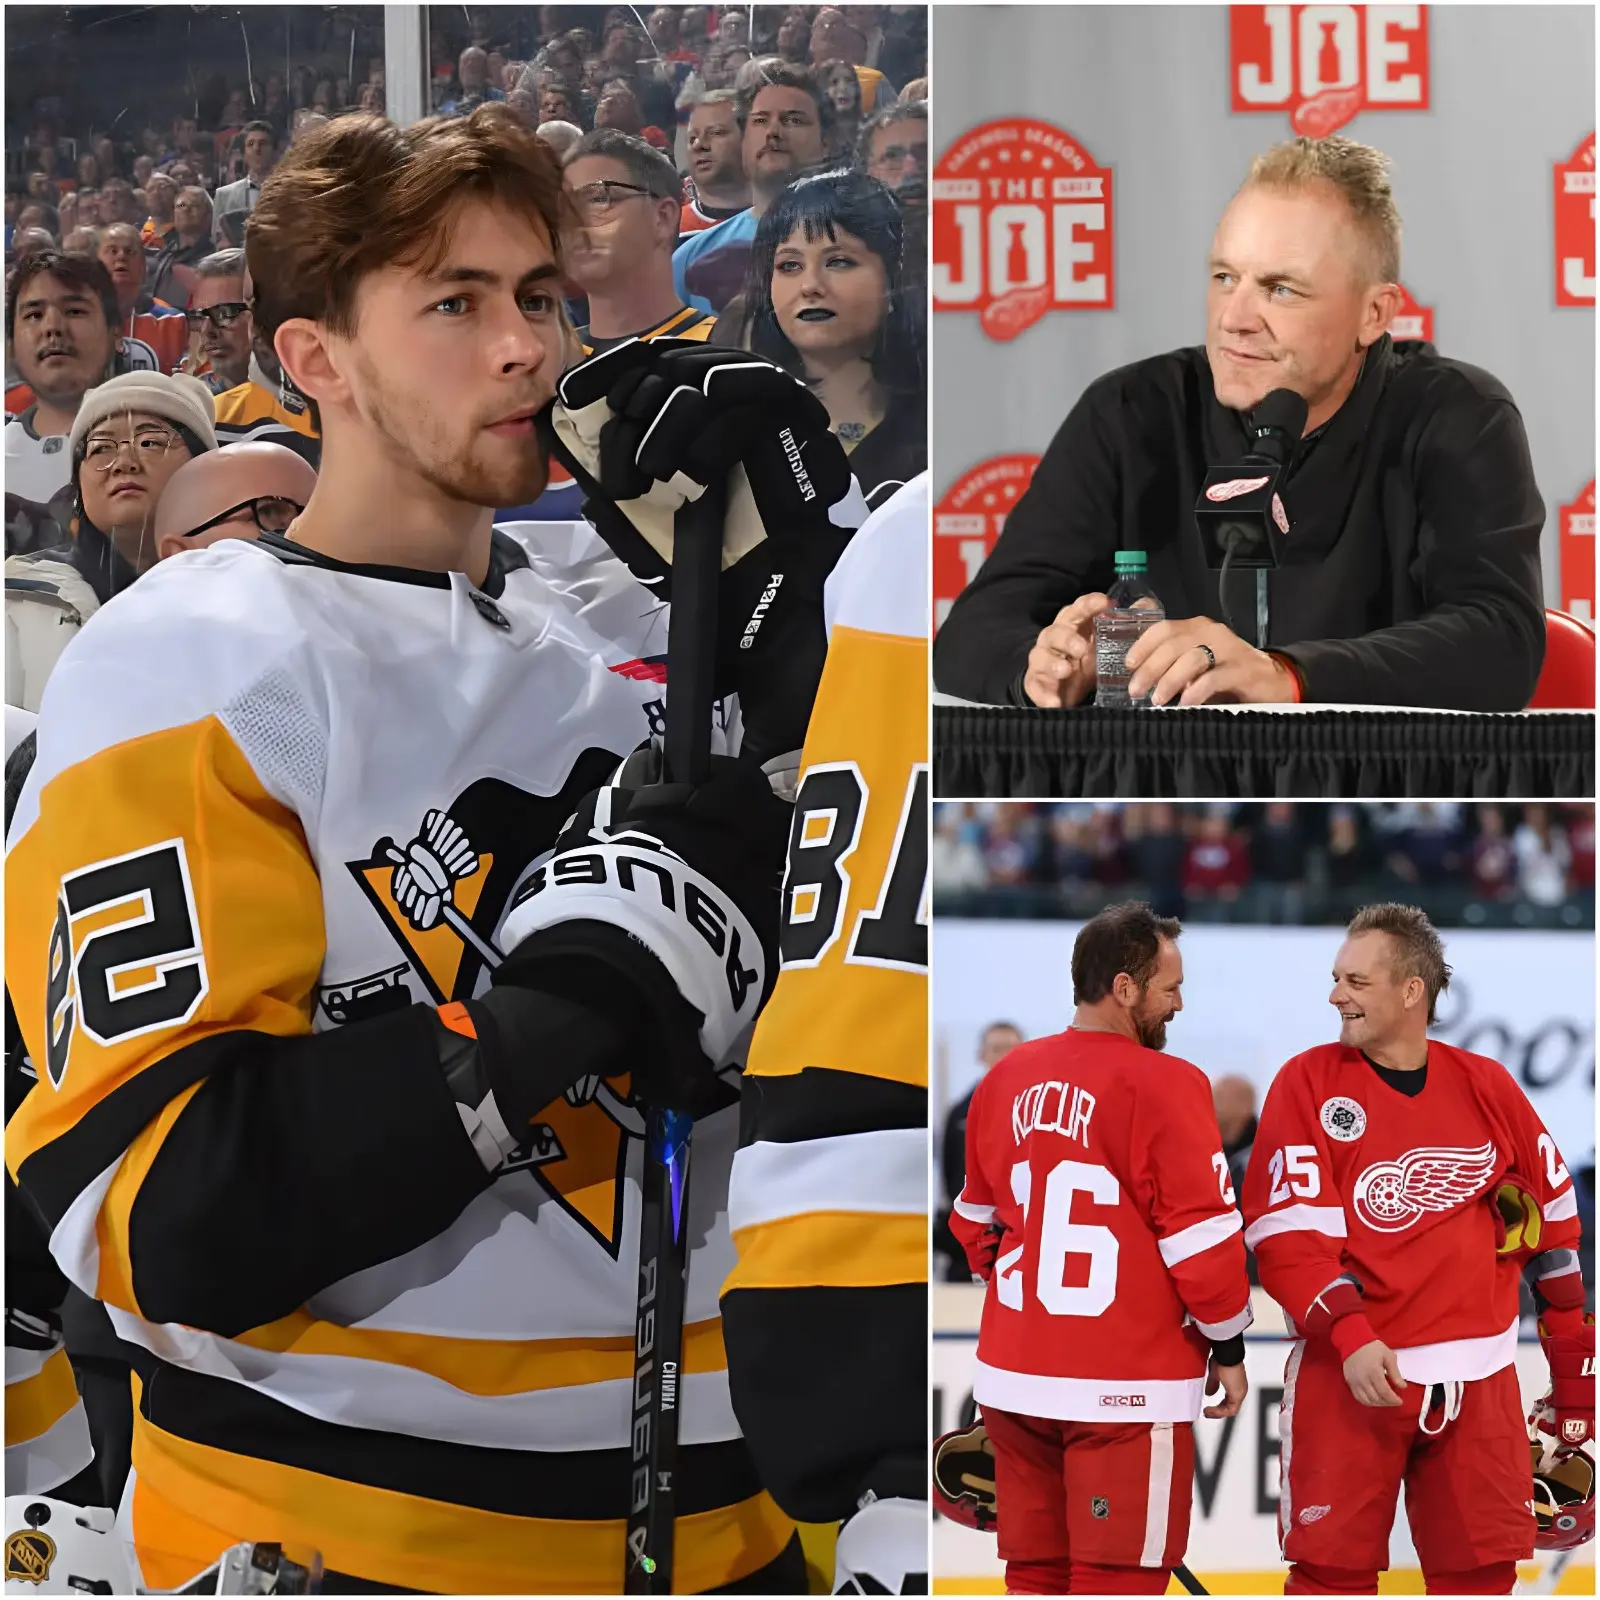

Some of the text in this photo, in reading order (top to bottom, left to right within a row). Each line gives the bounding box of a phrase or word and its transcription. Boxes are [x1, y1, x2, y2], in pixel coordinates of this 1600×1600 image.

[1238, 5, 1421, 104] JOE
[988, 177, 1046, 200] THE
[933, 203, 1106, 303] JOE
[1011, 1080, 1096, 1148] KOCUR
[1267, 1145, 1321, 1207] 25
[994, 1159, 1120, 1317] 26
[1100, 1395, 1146, 1407] CCM
